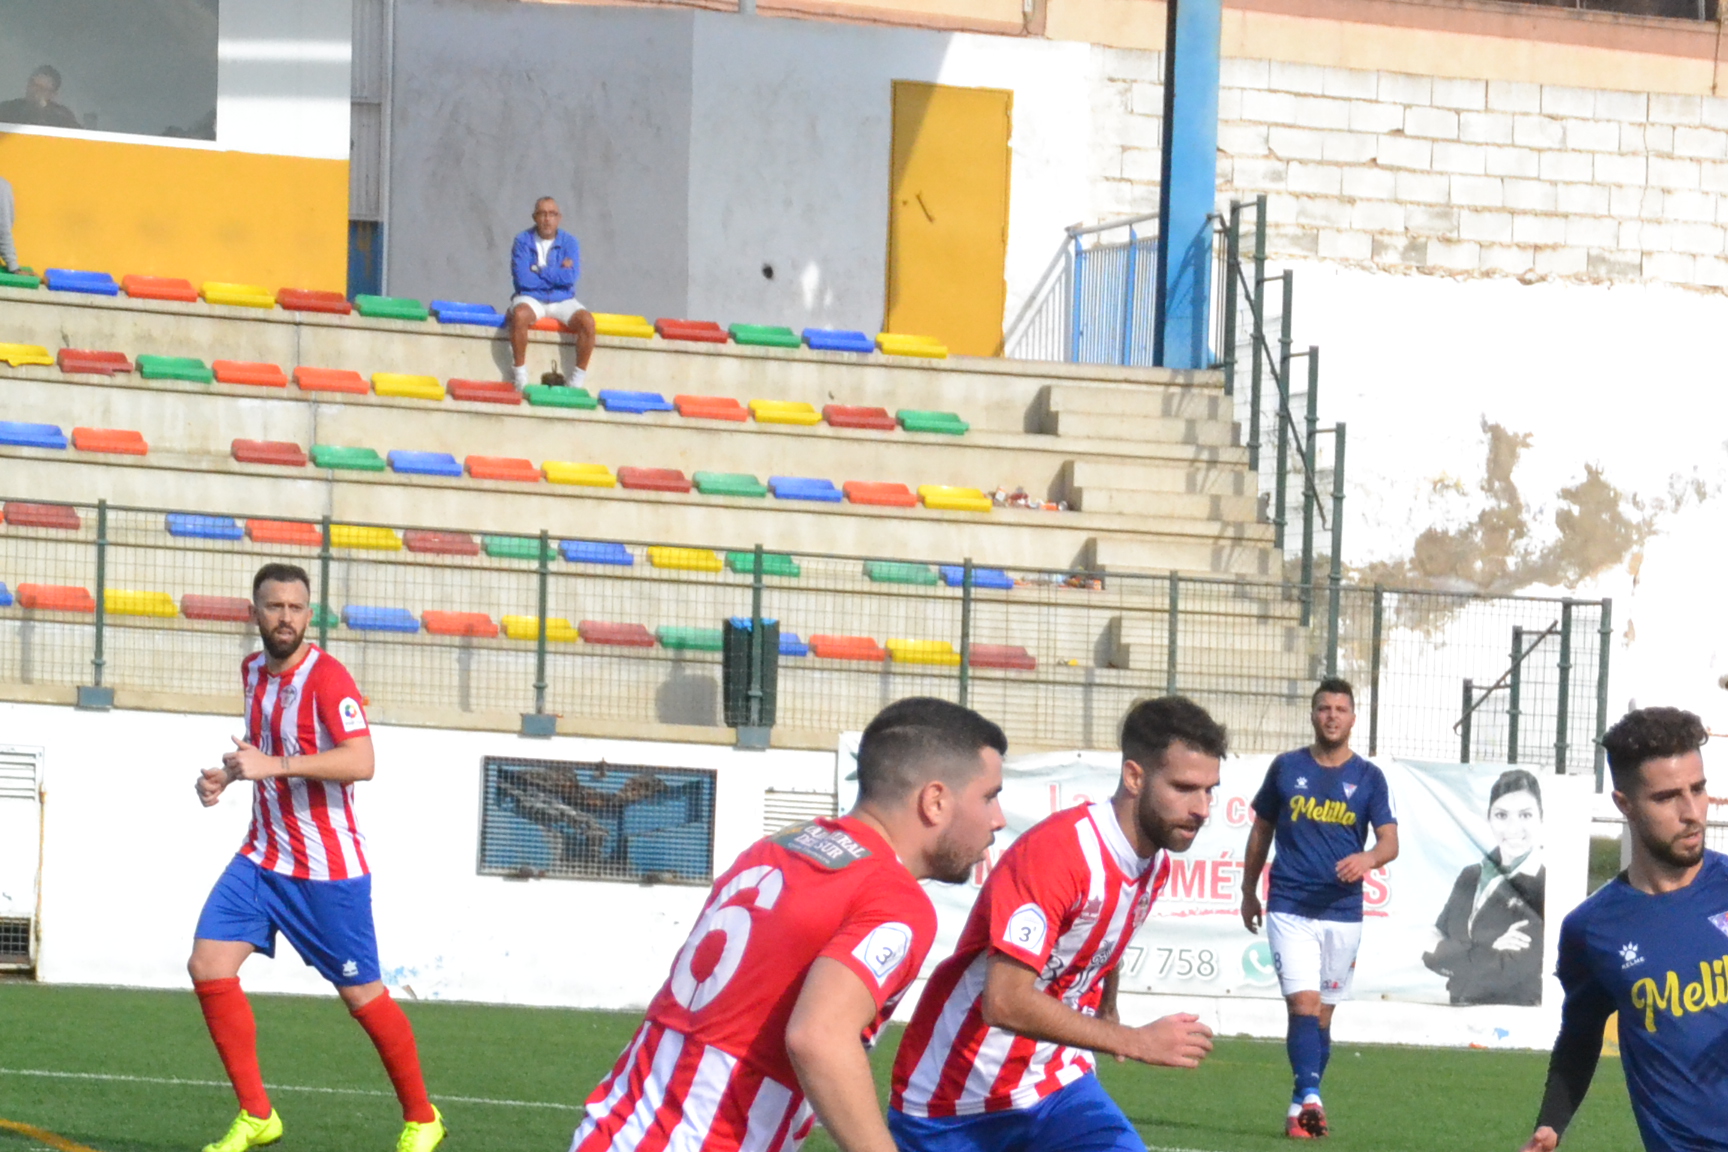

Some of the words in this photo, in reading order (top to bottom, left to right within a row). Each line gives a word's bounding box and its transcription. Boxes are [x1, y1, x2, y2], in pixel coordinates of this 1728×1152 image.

[1290, 795, 1357, 825] Melilla
[671, 865, 784, 1013] 6
[1156, 947, 1215, 977] 758
